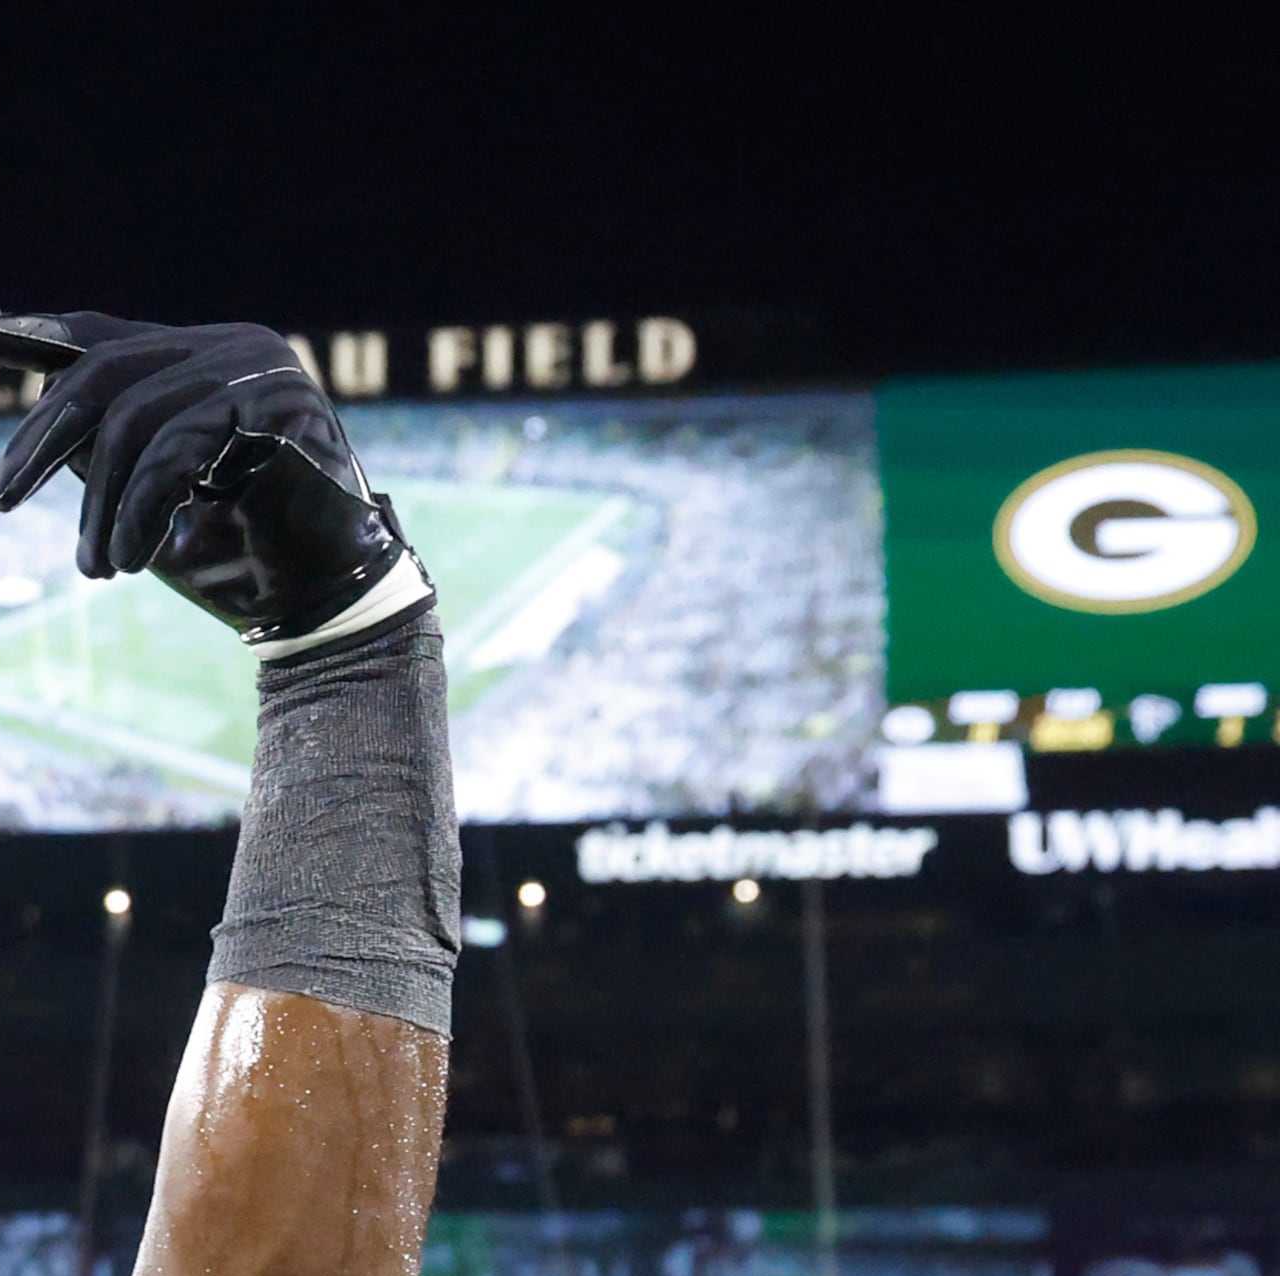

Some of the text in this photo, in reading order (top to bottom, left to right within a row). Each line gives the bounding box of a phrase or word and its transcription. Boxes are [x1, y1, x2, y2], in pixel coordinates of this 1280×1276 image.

[428, 316, 697, 393] FIELD
[1006, 460, 1240, 602] G
[576, 821, 939, 883] ticketmaster
